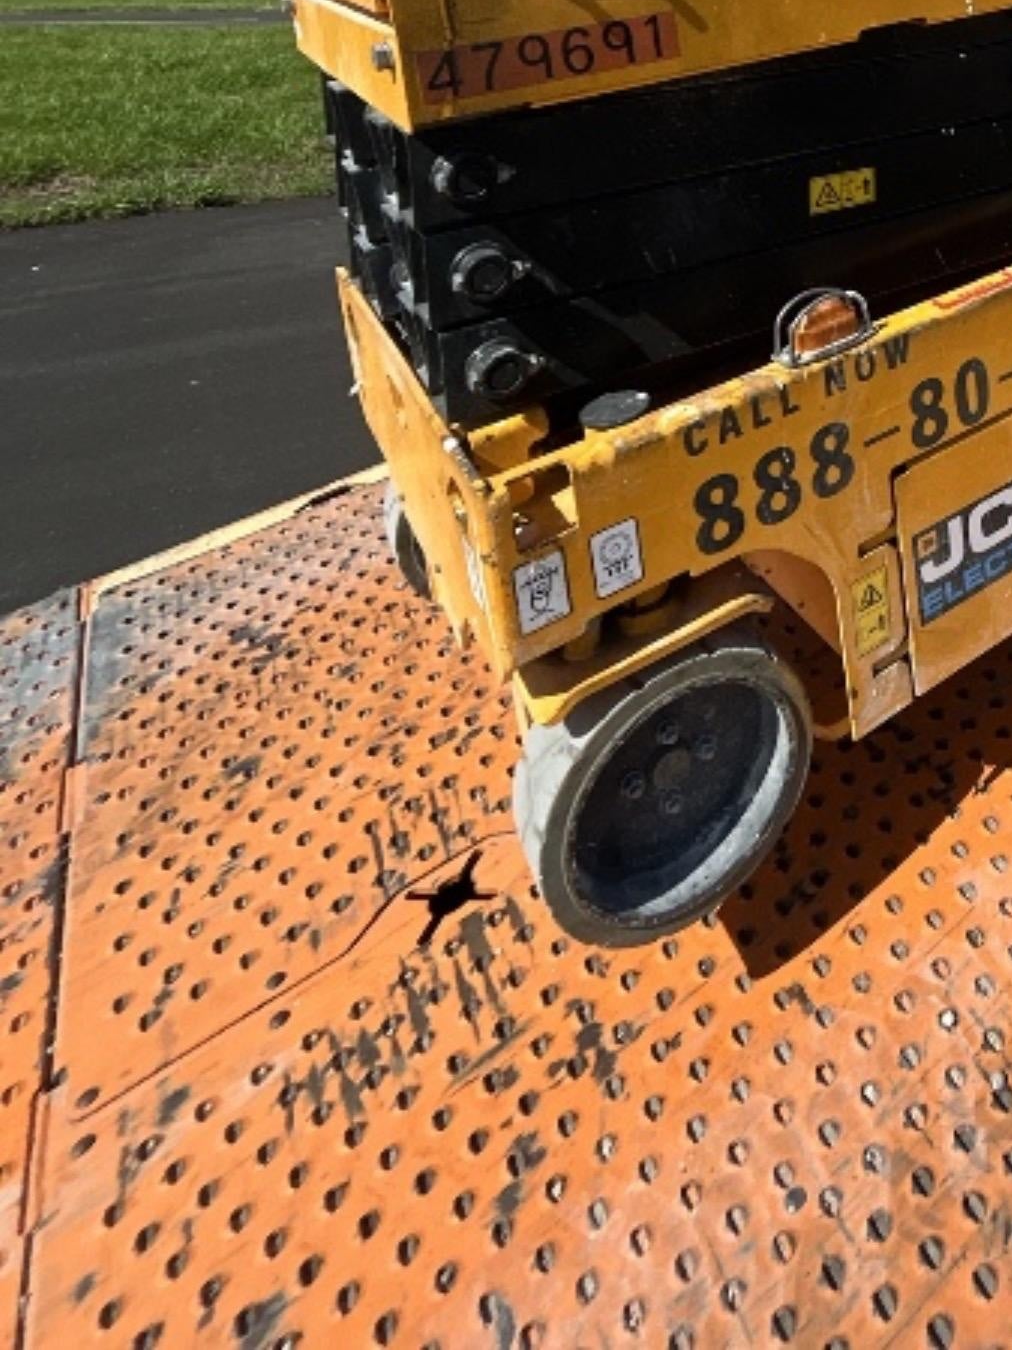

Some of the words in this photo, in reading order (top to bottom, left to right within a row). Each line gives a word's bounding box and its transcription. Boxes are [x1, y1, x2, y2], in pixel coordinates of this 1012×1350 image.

[426, 14, 666, 97] 479691
[683, 383, 800, 457] CALL
[824, 332, 910, 397] NOW
